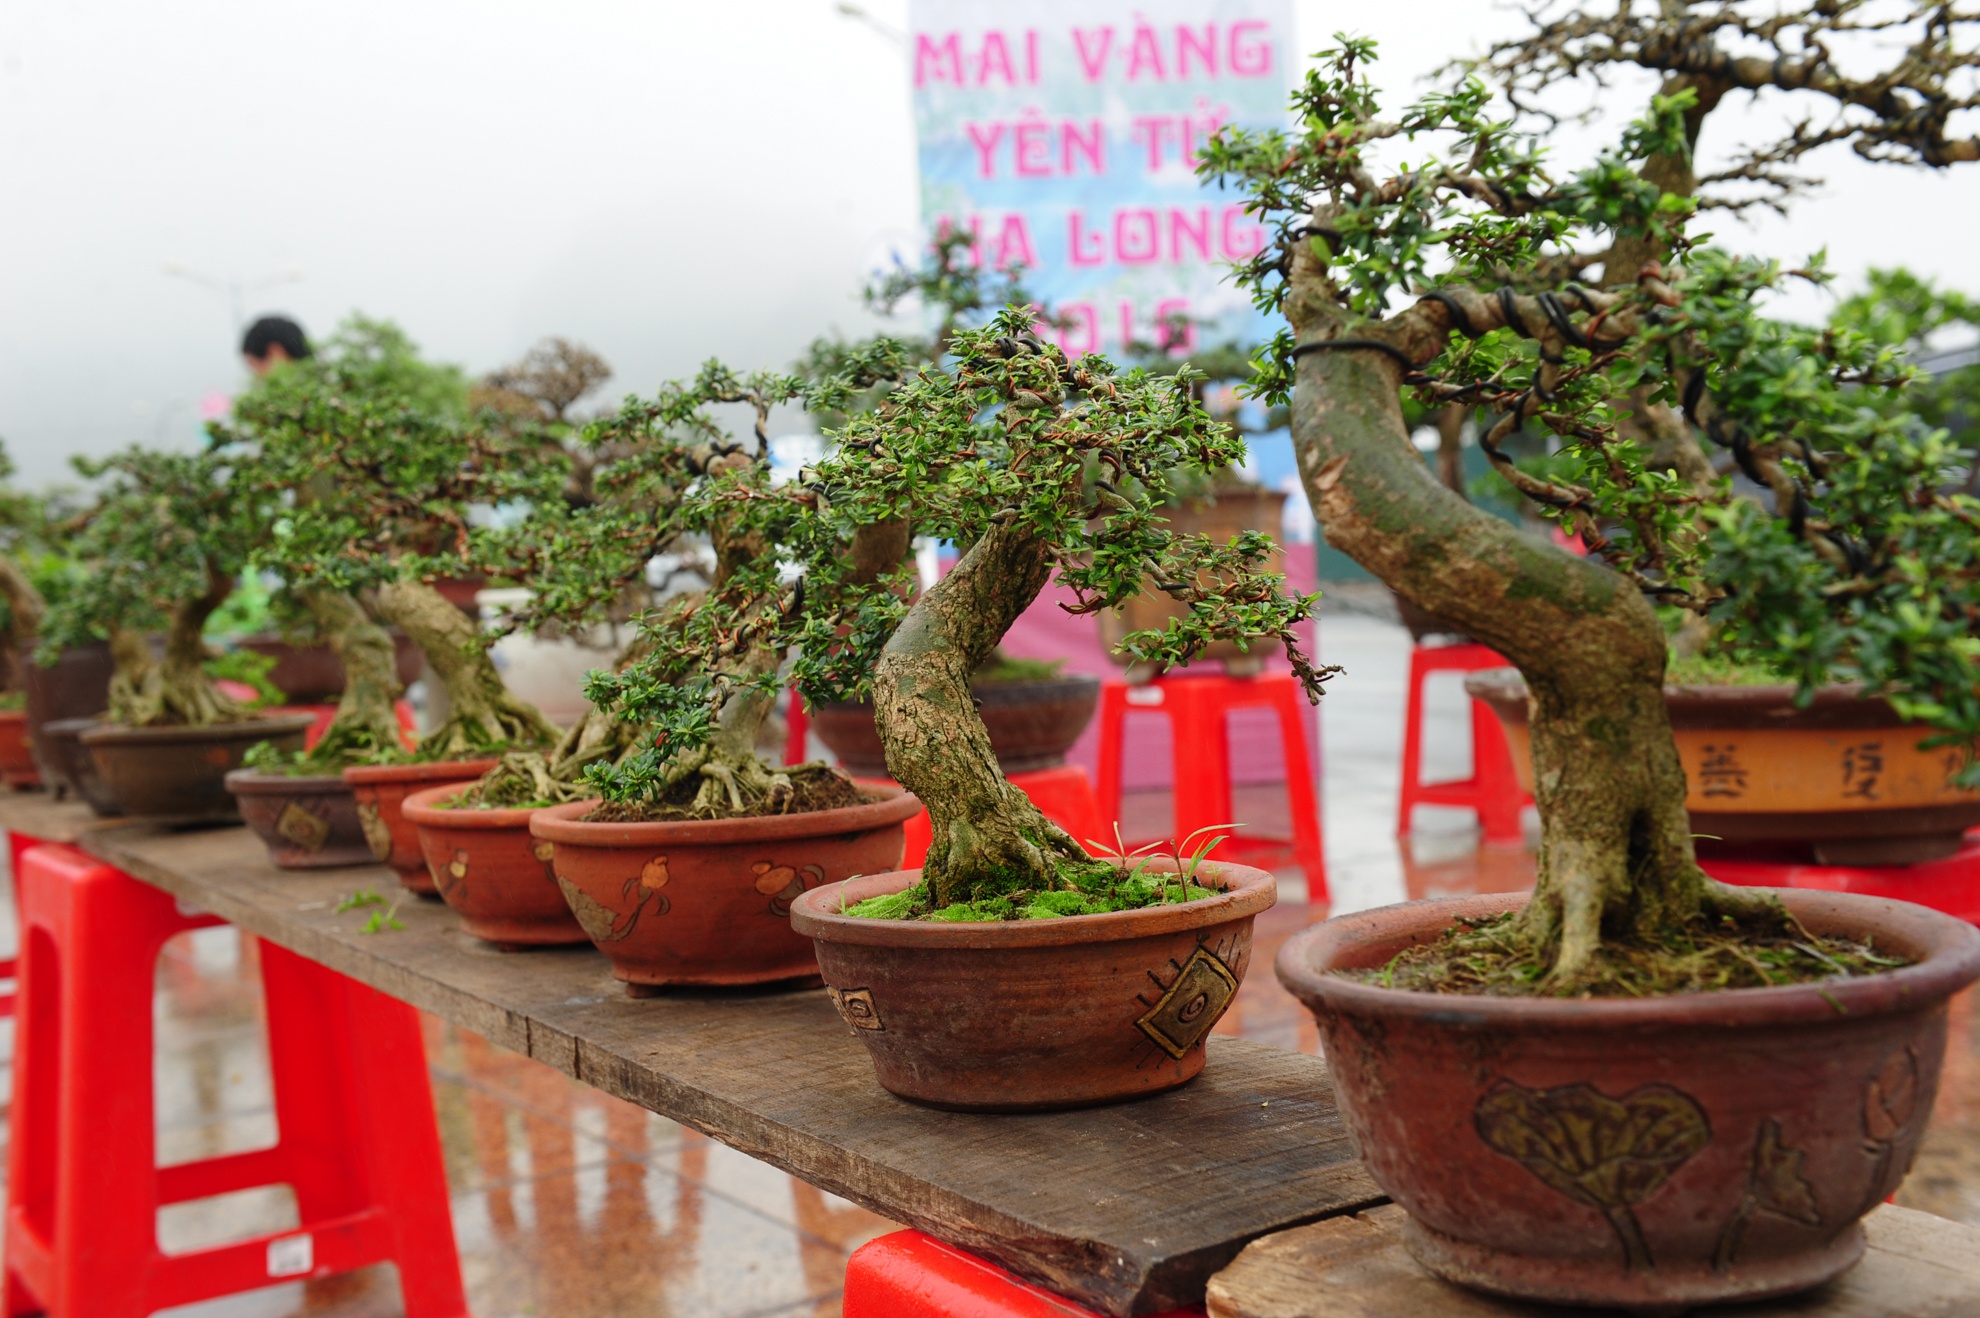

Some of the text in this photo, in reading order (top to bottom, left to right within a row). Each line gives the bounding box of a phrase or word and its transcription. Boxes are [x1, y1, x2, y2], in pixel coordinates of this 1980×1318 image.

[914, 10, 1275, 88] MAI VÀNG
[964, 107, 1108, 179] YÊN
[1066, 205, 1266, 268] LONG
